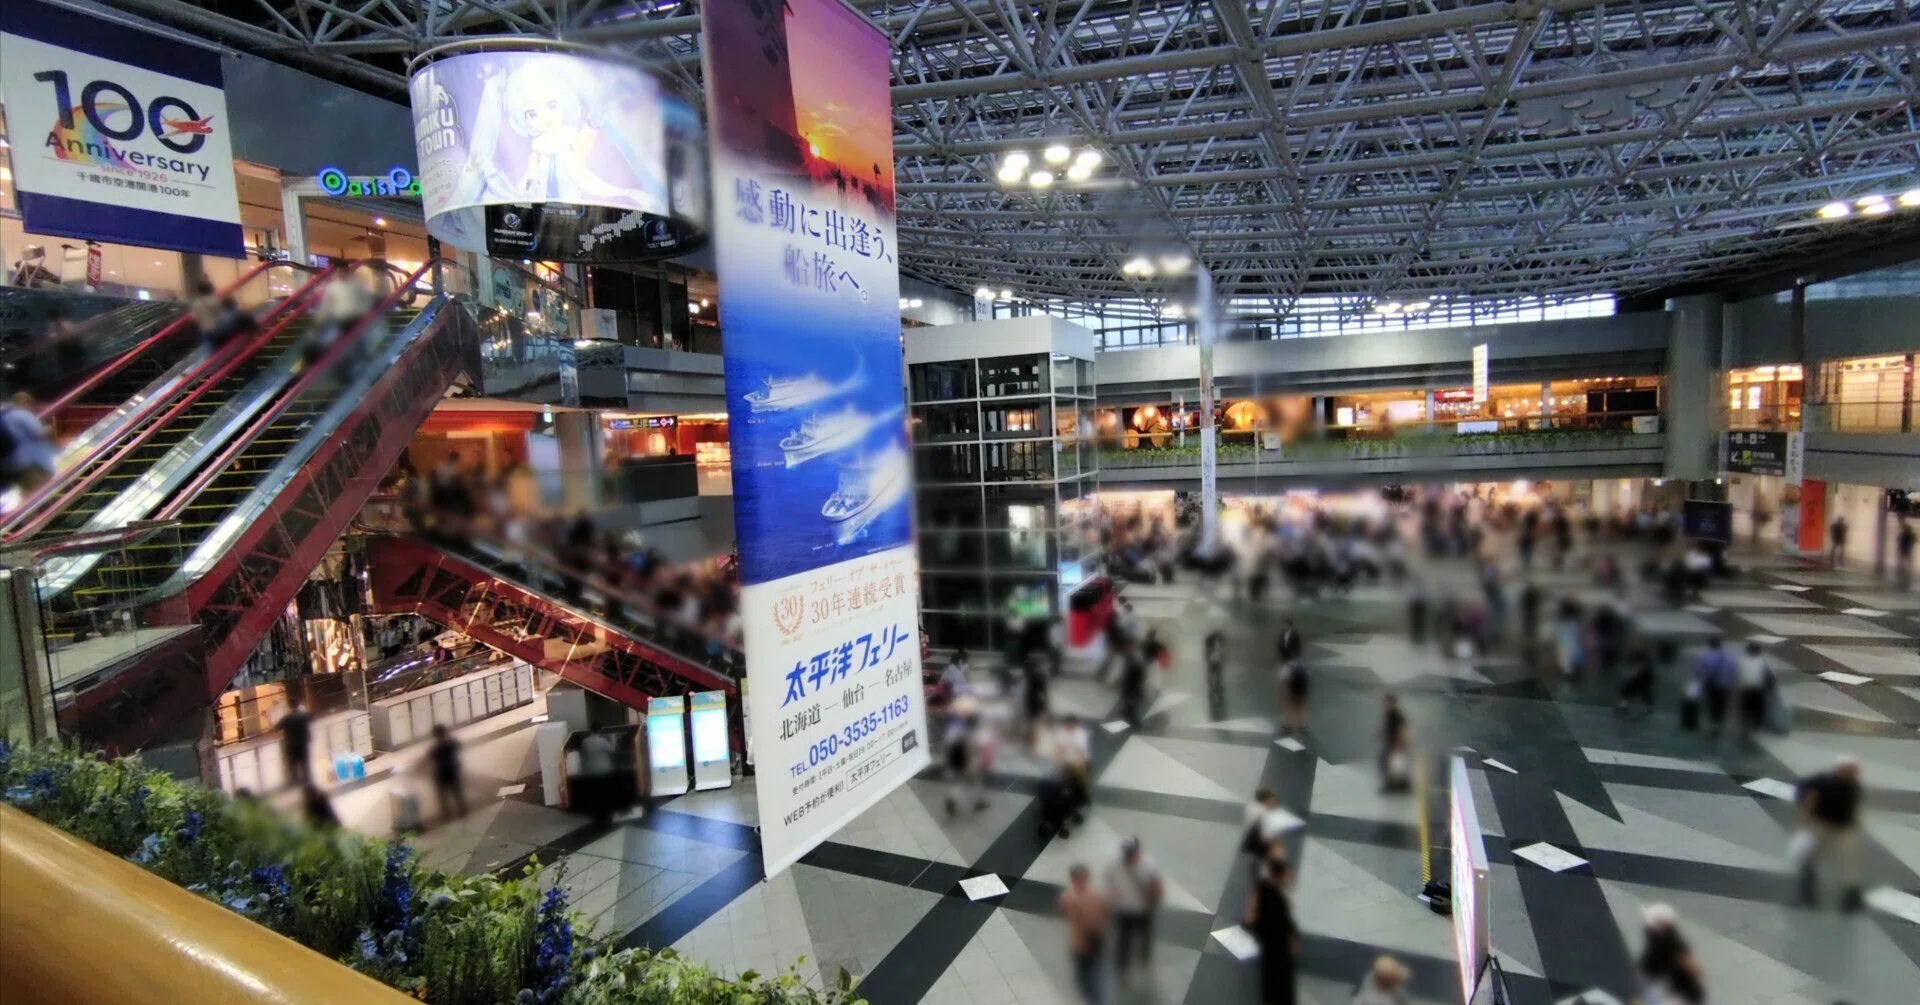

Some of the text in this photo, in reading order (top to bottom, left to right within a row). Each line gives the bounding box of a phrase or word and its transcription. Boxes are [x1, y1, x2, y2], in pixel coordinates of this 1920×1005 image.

[34, 70, 205, 154] 100
[45, 131, 210, 181] Anniversary
[420, 128, 456, 157] TOWN
[100, 164, 168, 182] since 1926
[317, 168, 388, 196] Oasis
[735, 177, 892, 263] 感動に出逢う、
[783, 244, 868, 301] 船旅へ。
[781, 595, 798, 620] 30
[811, 571, 906, 624] 30年連続受賞
[780, 623, 909, 709] 太平洋フェリー
[779, 658, 912, 741] 北海道 仙台 名古屋
[850, 752, 892, 784] 太平洋フェリー
